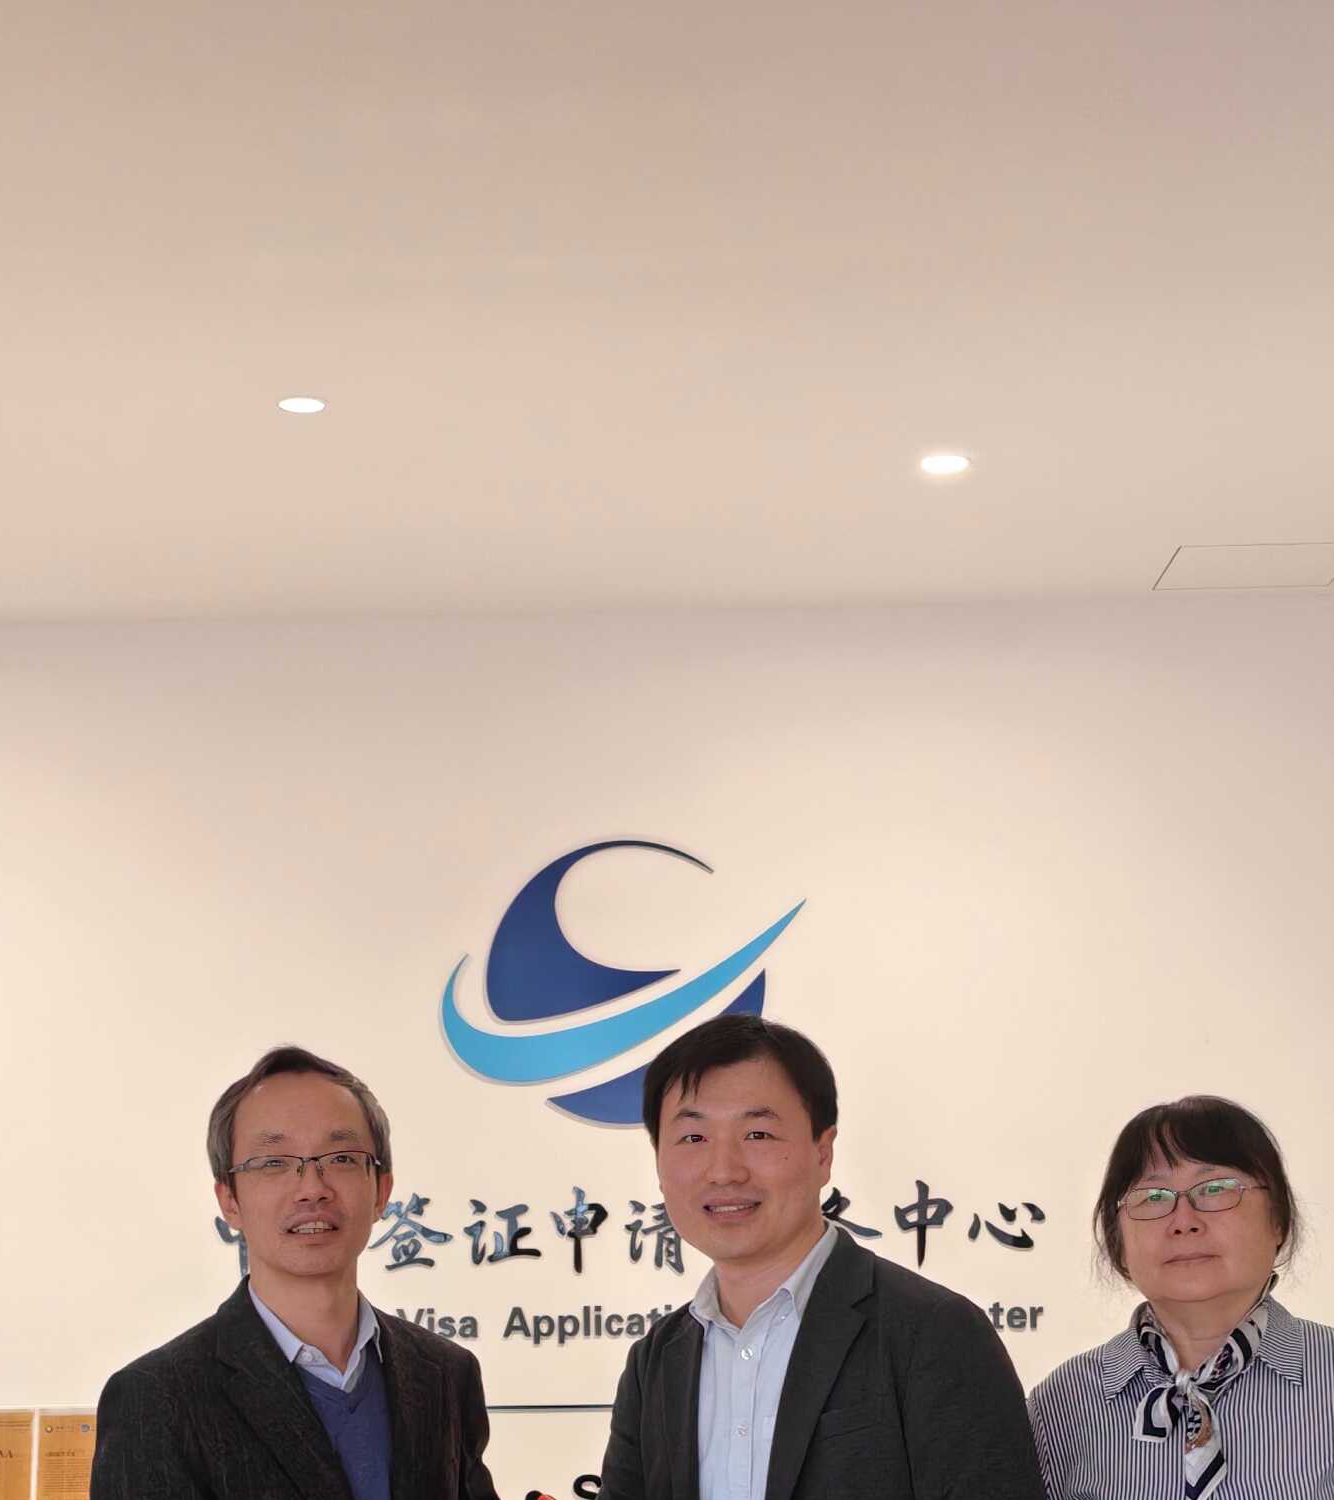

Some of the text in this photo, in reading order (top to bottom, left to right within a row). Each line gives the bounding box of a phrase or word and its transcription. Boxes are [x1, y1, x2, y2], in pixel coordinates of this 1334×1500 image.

[396, 1302, 1044, 1346] Visa Applicat ter
